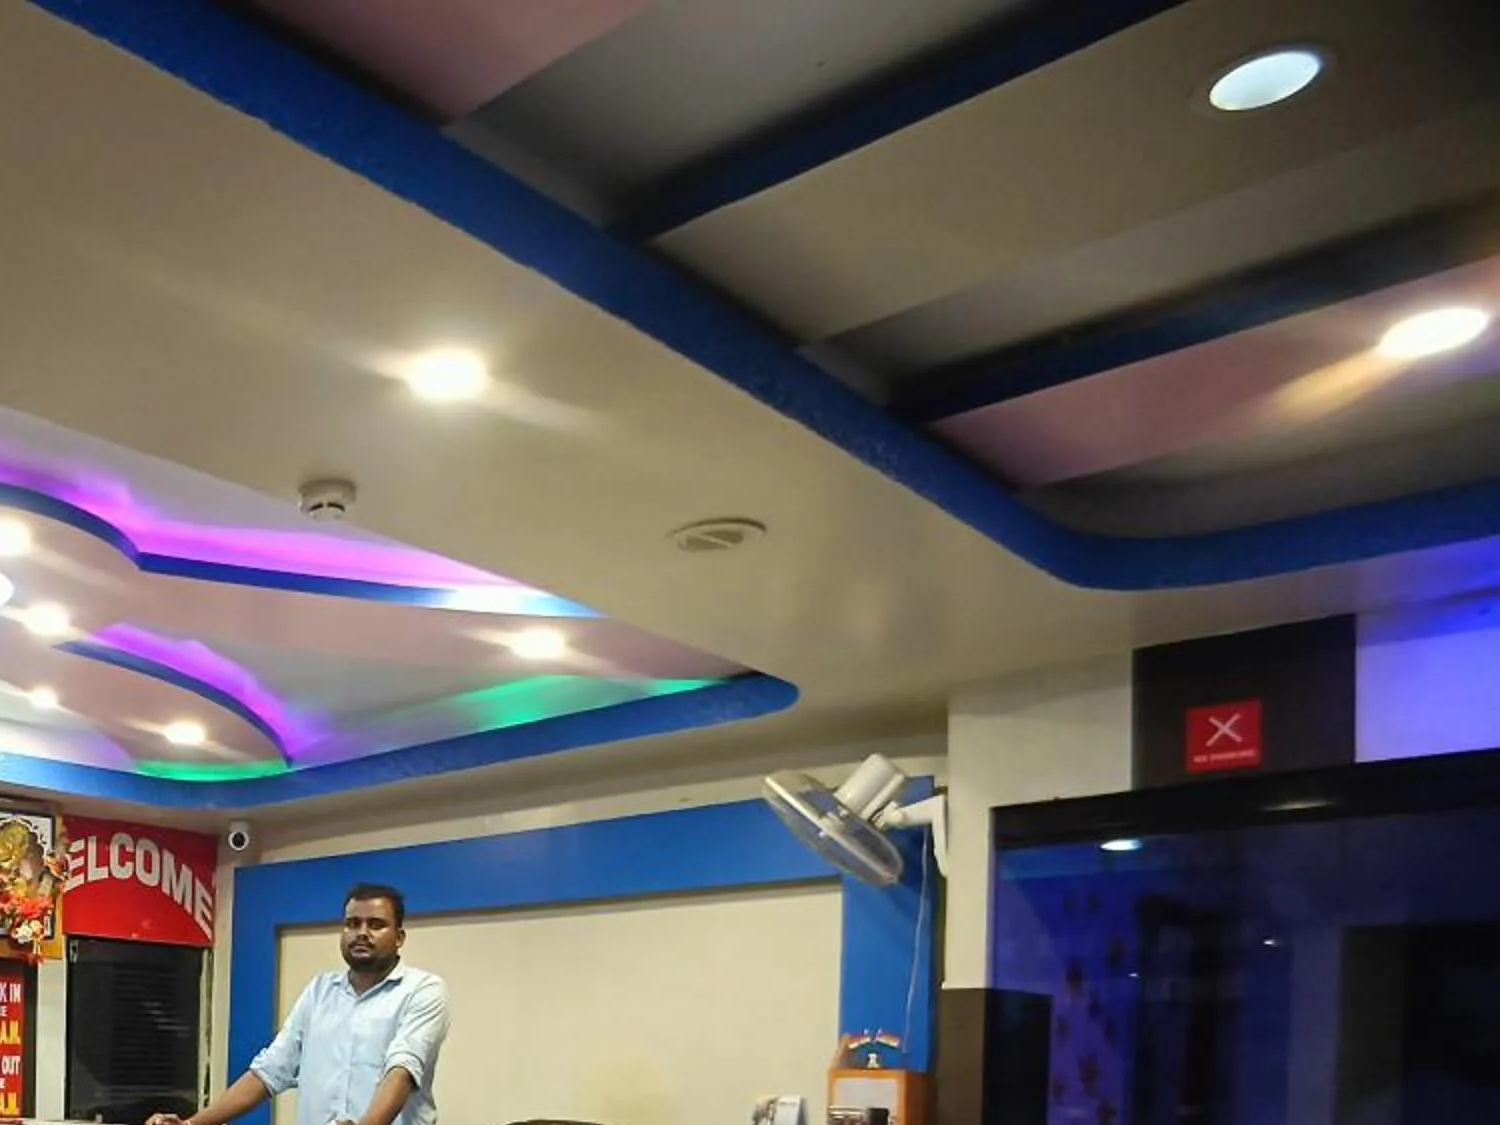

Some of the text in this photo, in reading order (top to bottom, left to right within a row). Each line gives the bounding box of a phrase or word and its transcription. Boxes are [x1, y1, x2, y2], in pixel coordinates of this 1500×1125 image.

[64, 832, 214, 941] ELCOME
[9, 982, 21, 1003] IN
[1, 1055, 21, 1076] OUT
